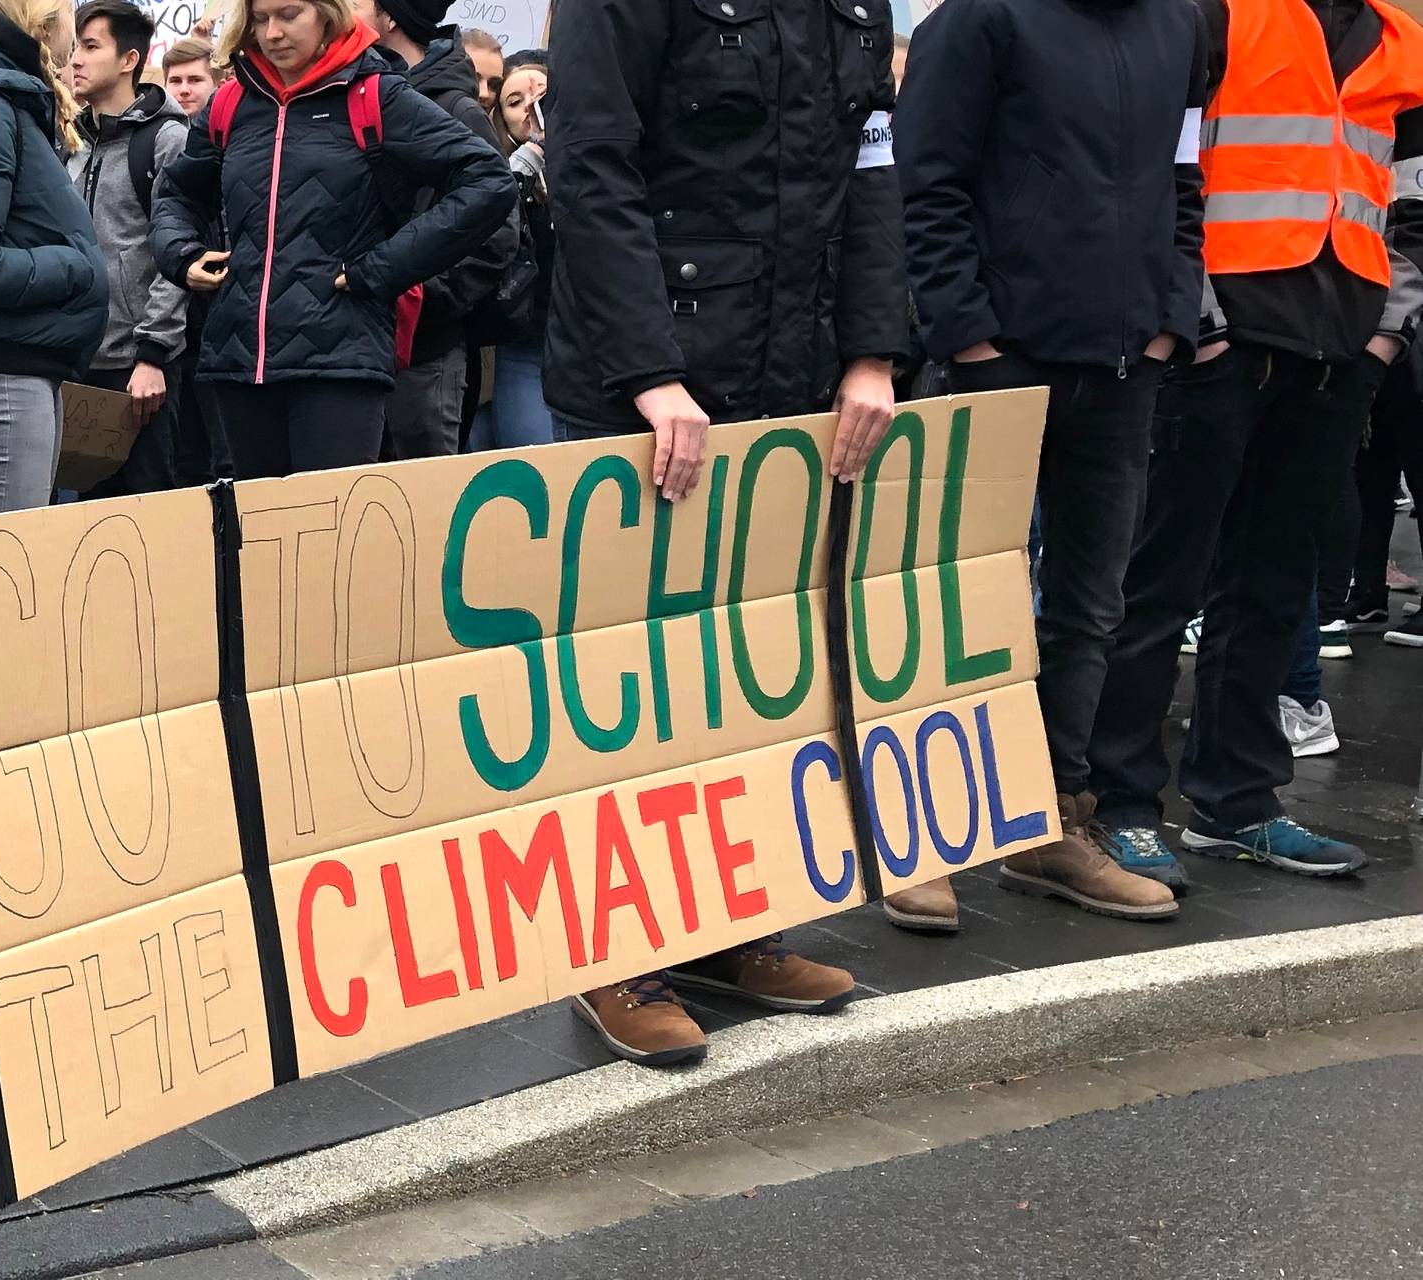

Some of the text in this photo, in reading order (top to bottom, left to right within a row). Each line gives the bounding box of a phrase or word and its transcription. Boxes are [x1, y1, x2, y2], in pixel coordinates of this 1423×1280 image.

[458, 0, 507, 24] SIND
[242, 473, 425, 836] TO
[442, 405, 1012, 792] SCHOOL
[297, 776, 770, 1038] CLIMATE
[790, 701, 1049, 904] COOL
